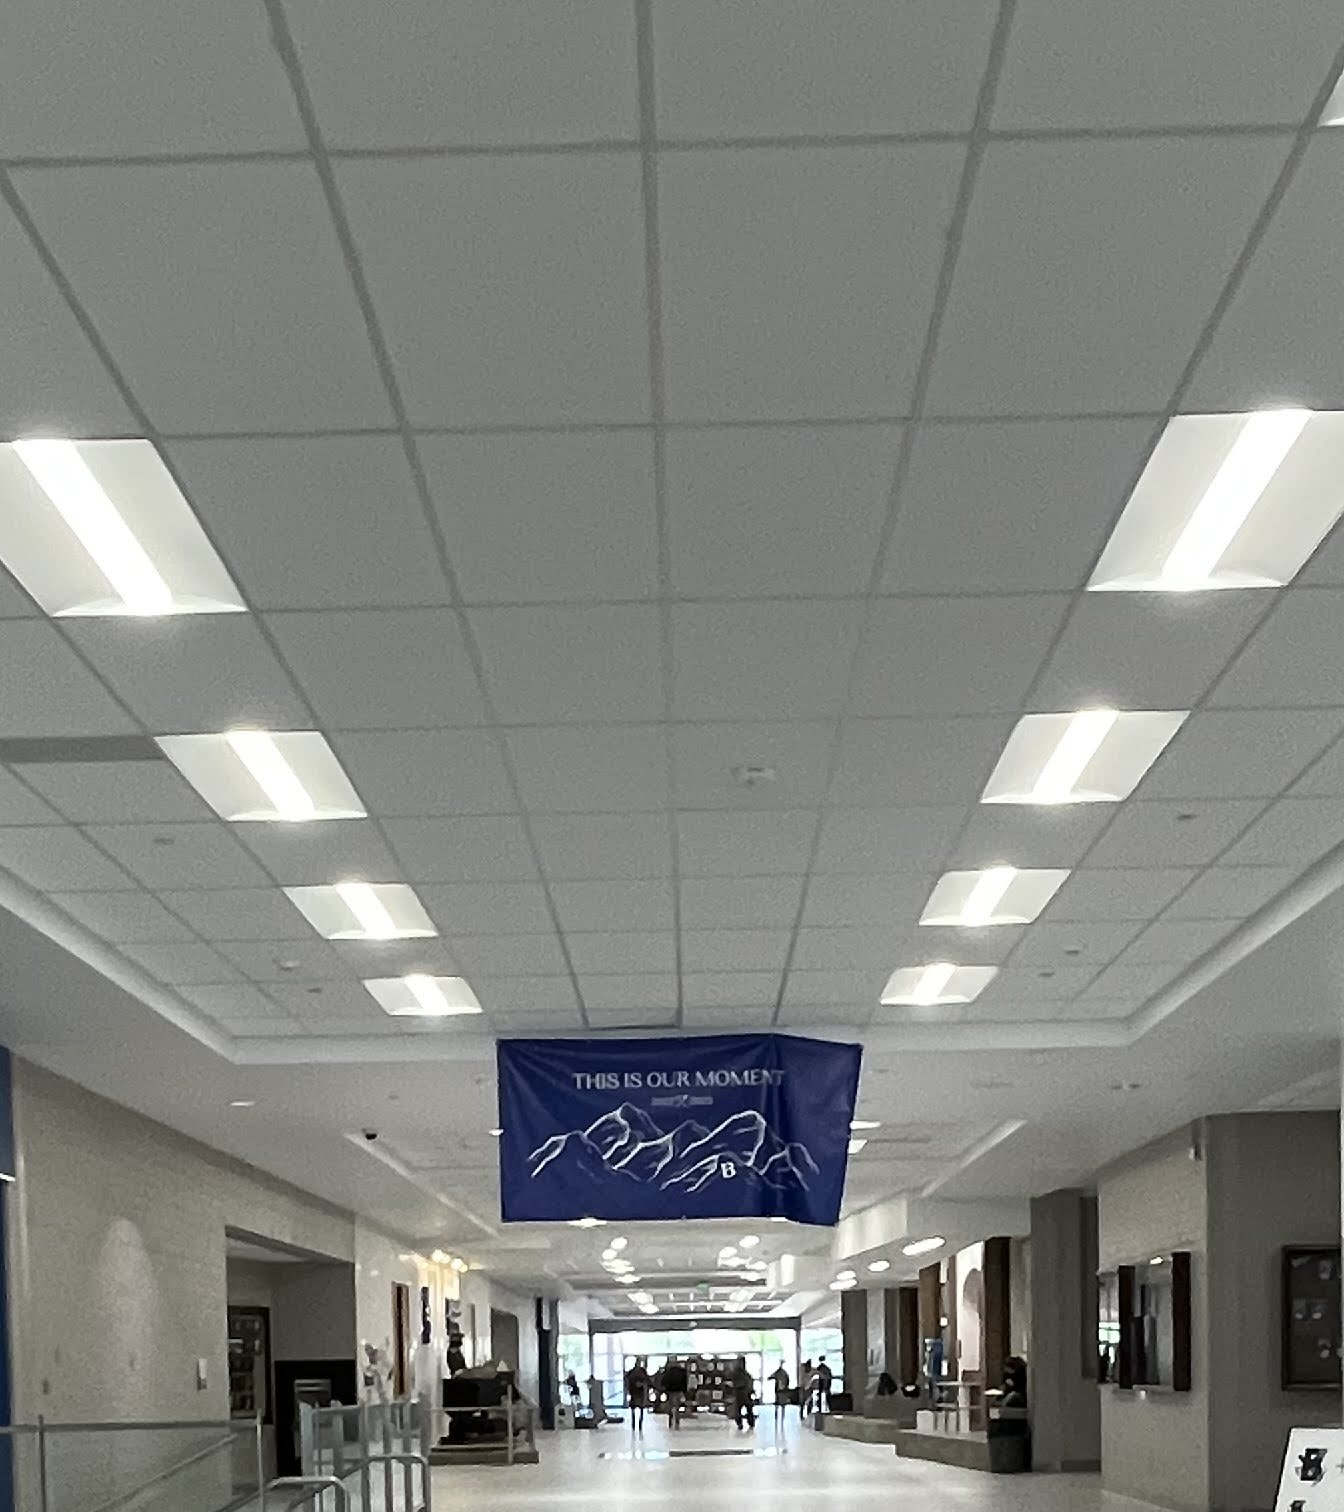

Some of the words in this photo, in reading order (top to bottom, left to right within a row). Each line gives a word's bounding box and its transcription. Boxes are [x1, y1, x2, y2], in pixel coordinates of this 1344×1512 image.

[573, 1072, 620, 1090] THIS
[625, 1072, 642, 1090] IS
[646, 1071, 690, 1088] OUR
[695, 1069, 785, 1087] MOMENT
[721, 1161, 736, 1178] B
